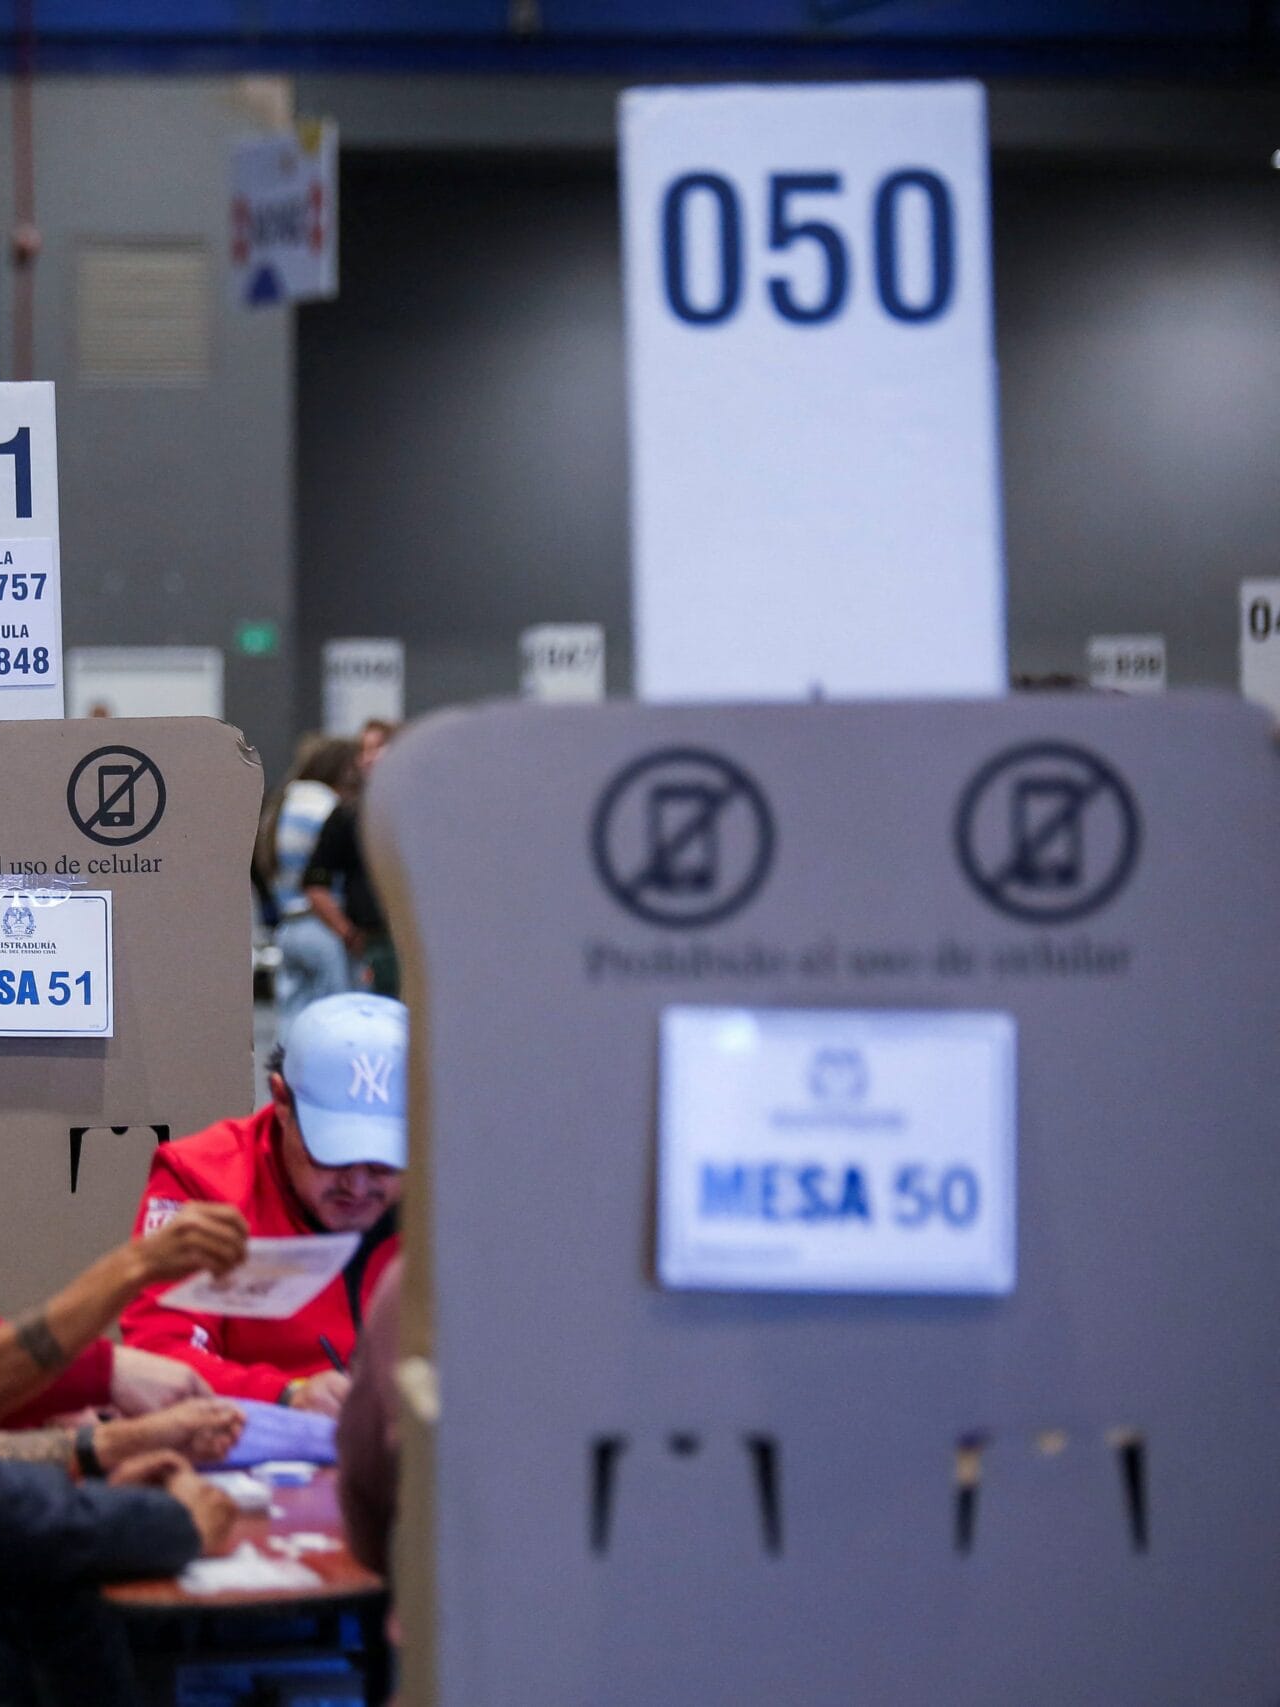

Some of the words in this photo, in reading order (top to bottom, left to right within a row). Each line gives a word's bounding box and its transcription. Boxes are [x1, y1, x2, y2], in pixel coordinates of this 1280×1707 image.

[661, 168, 956, 328] 050
[10, 862, 47, 876] uso
[54, 855, 81, 875] de
[87, 853, 163, 874] celular
[47, 970, 92, 1006] 51
[698, 1160, 873, 1224] MESA
[892, 1162, 981, 1230] 50
